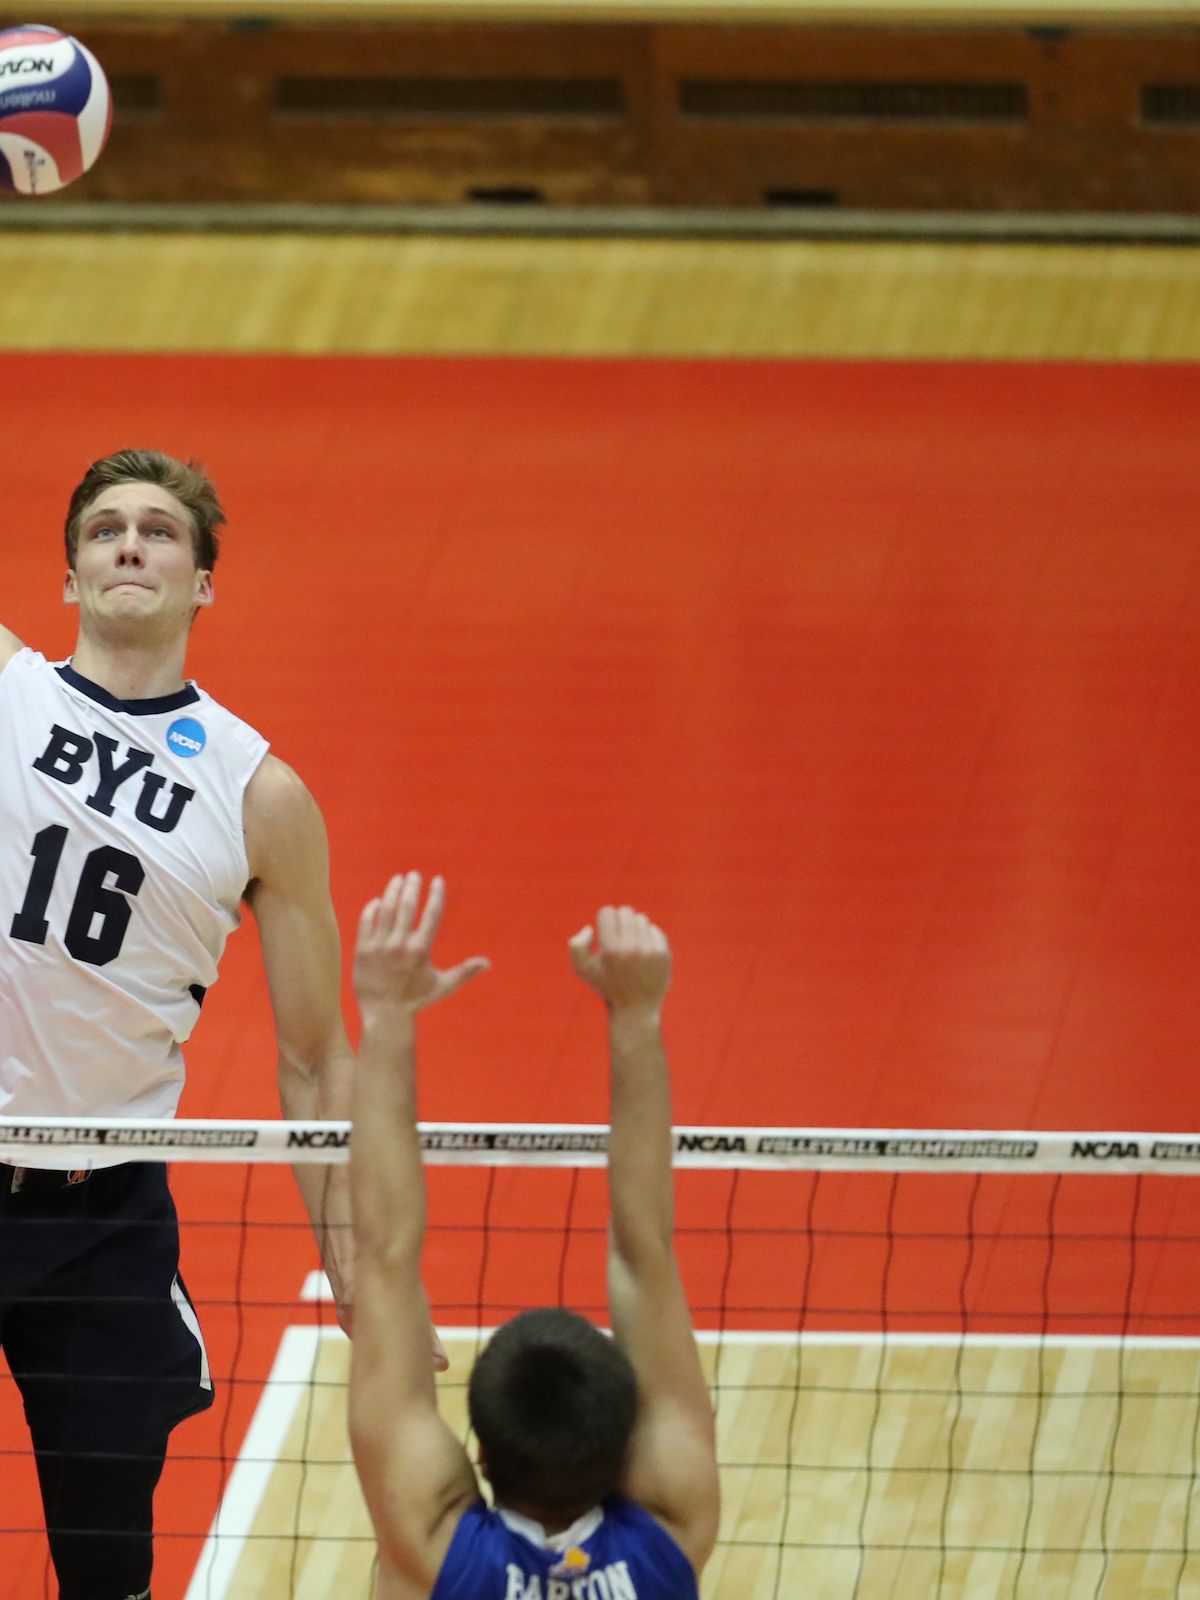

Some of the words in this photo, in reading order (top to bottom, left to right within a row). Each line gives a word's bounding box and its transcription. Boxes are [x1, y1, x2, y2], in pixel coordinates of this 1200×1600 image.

[168, 731, 203, 753] NCAA
[32, 723, 196, 833] BYU
[9, 824, 146, 967] 16
[105, 1129, 256, 1146] CHAMPIONSHIP
[678, 1134, 746, 1152] NCAA
[1071, 1141, 1140, 1160] NCAA
